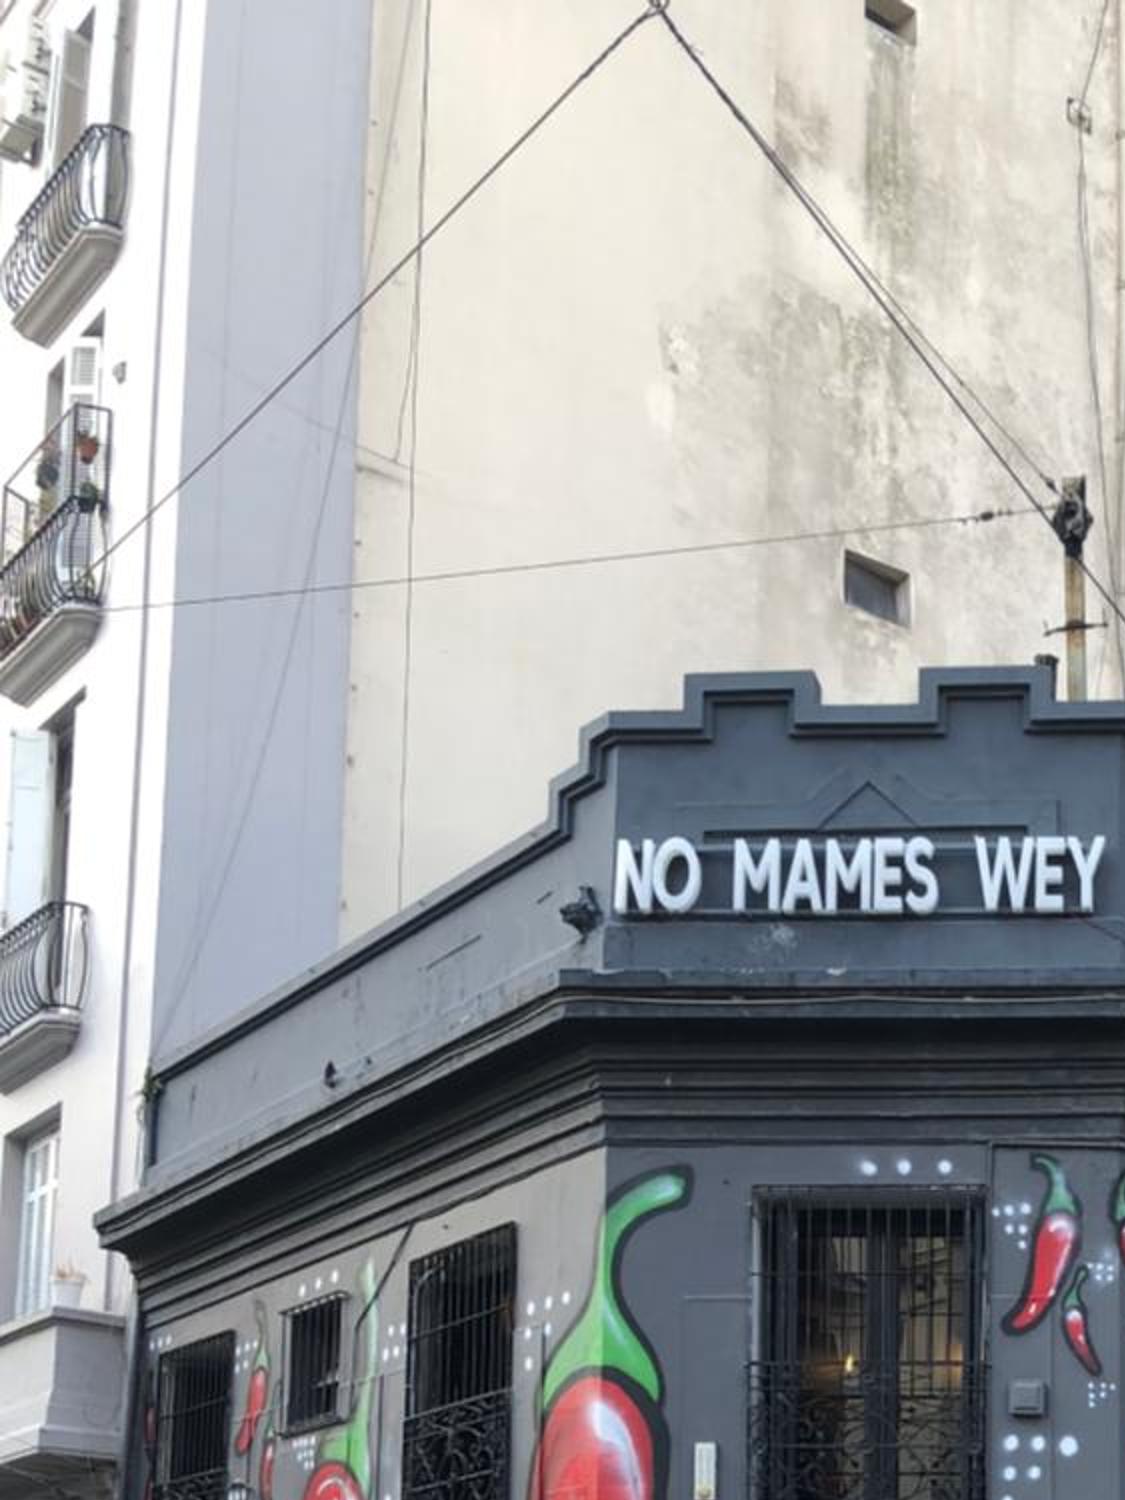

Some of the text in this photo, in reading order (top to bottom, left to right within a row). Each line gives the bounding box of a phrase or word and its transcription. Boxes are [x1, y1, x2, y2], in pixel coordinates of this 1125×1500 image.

[614, 835, 1105, 914] NO MAMES WEY
